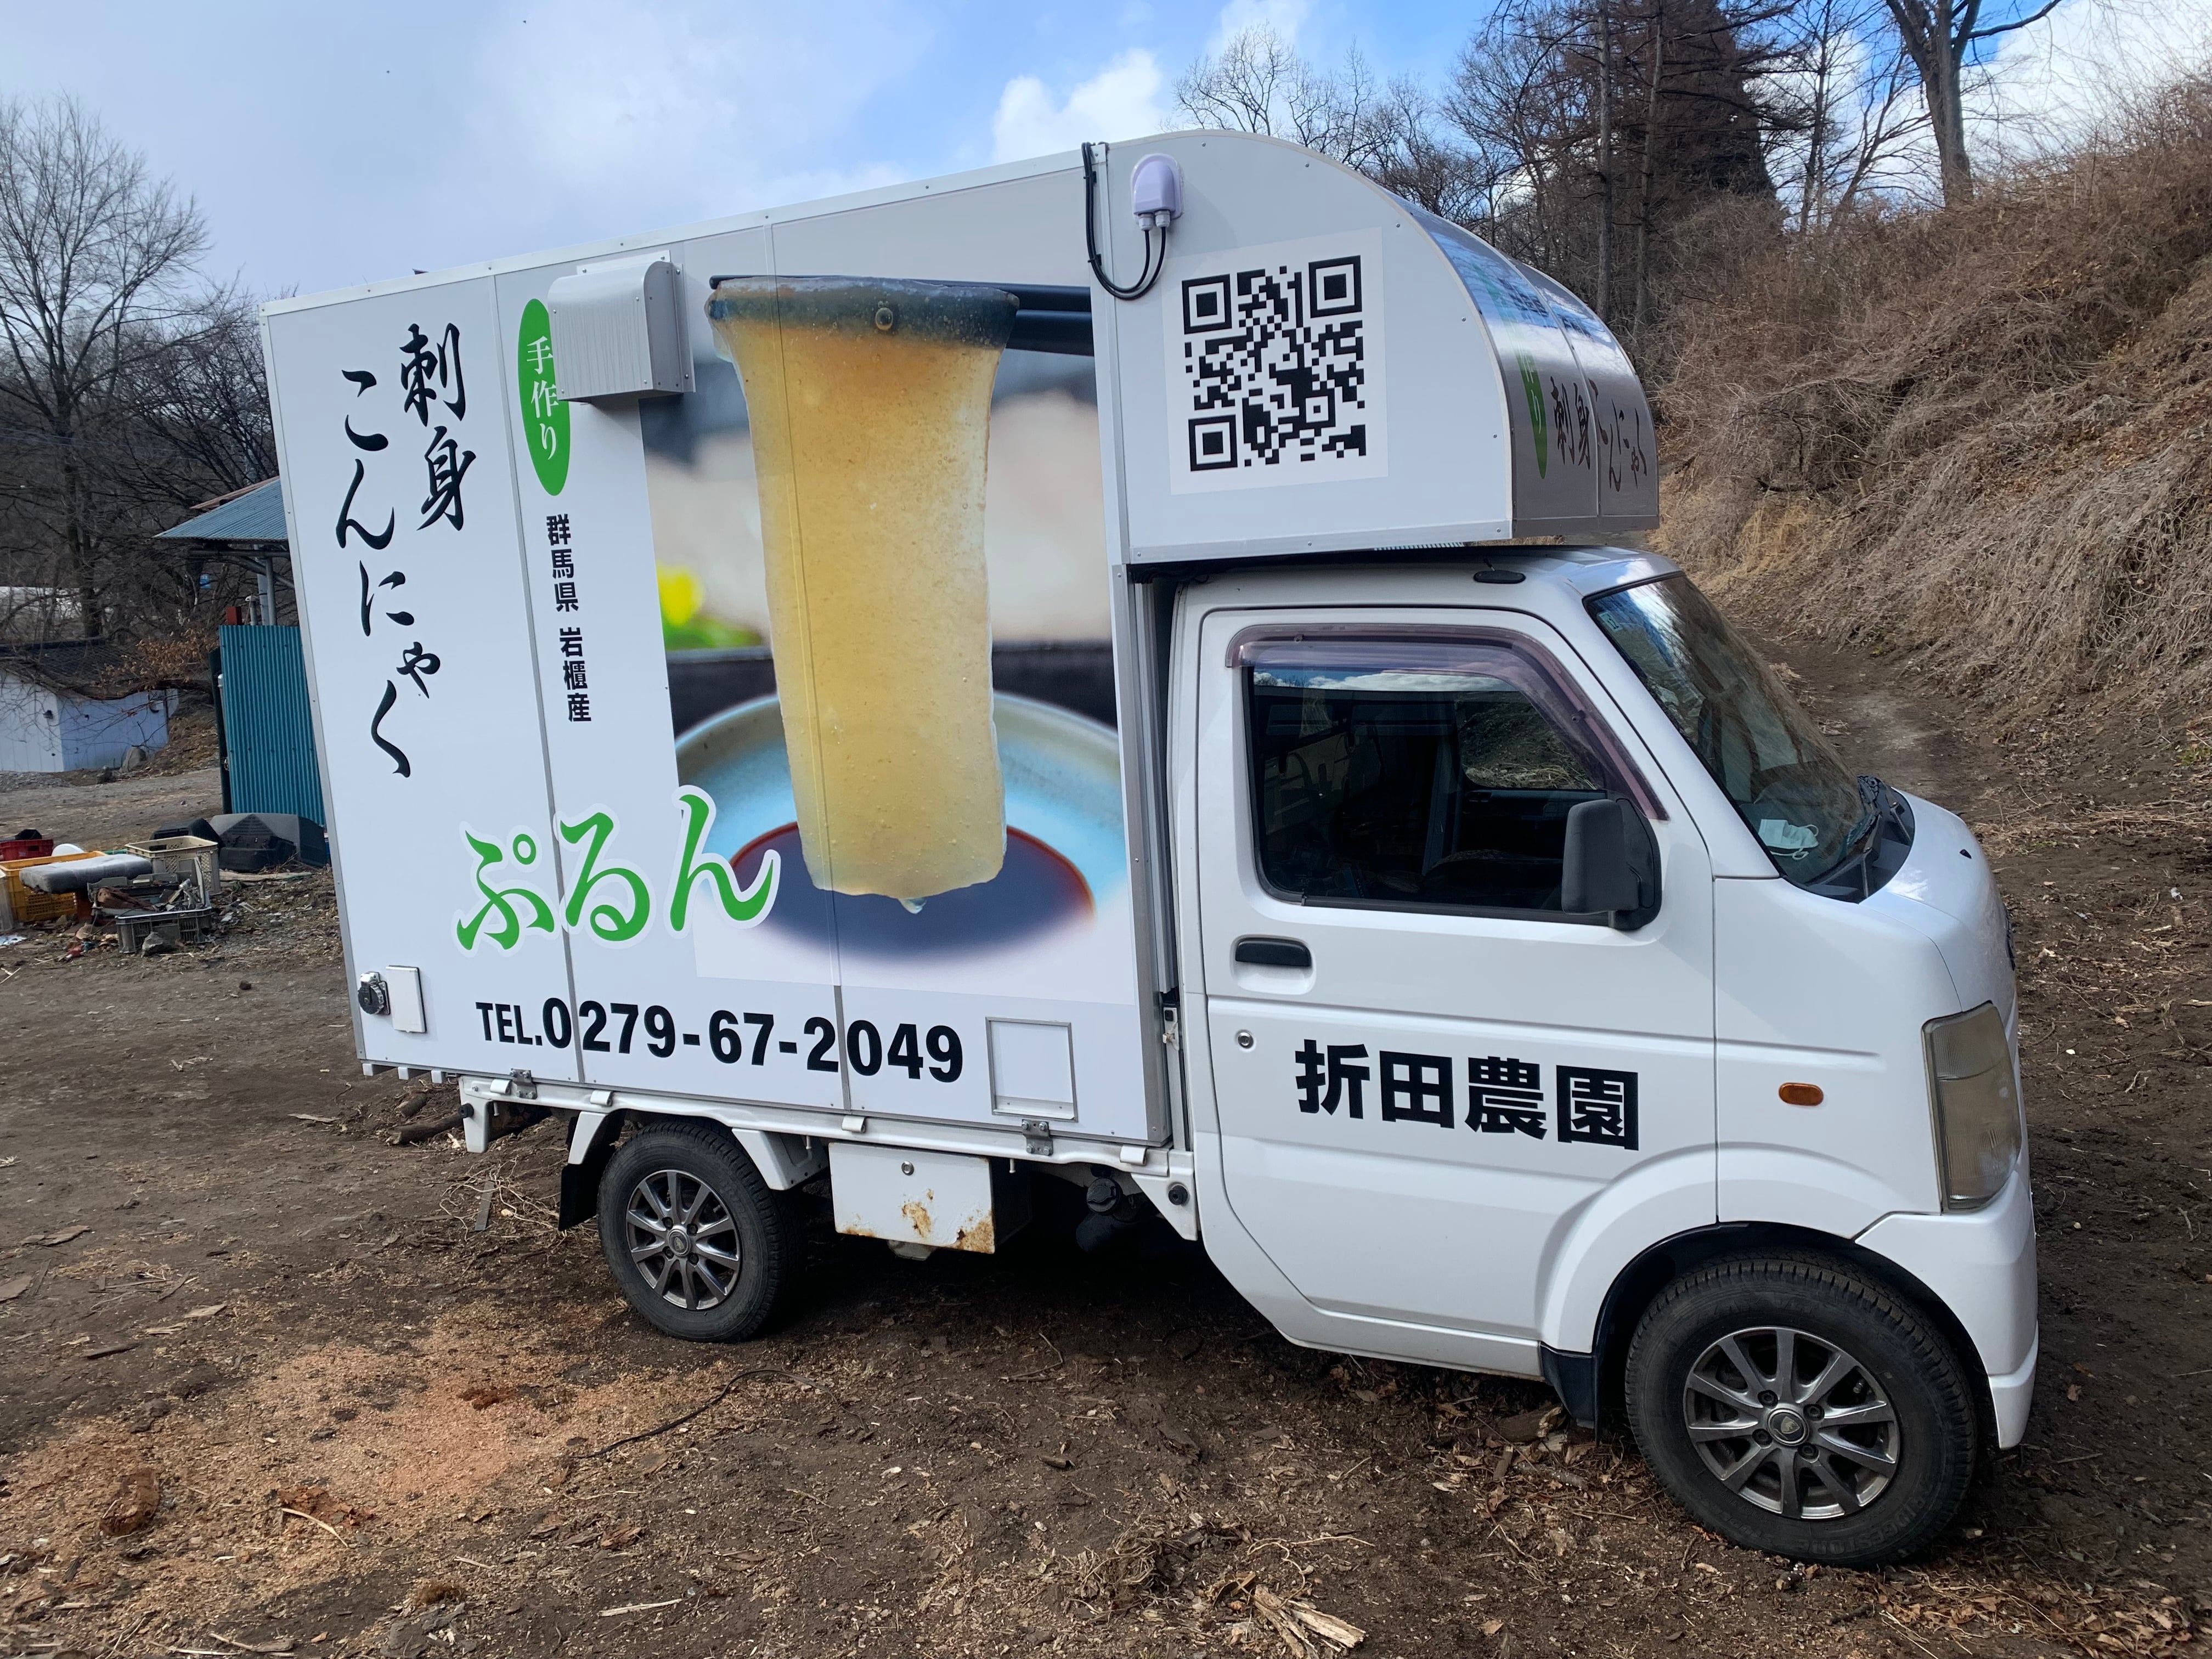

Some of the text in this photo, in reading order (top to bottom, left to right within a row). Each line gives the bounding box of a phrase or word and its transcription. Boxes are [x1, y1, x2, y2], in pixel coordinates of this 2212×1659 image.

[399, 323, 477, 531] 刺身
[527, 336, 560, 460] 手作り
[336, 370, 441, 778] こんにゃく
[546, 514, 592, 723] 群馬県 岩櫃産
[456, 794, 773, 950] ぷるん
[1295, 1039, 1639, 1151] 折田農園
